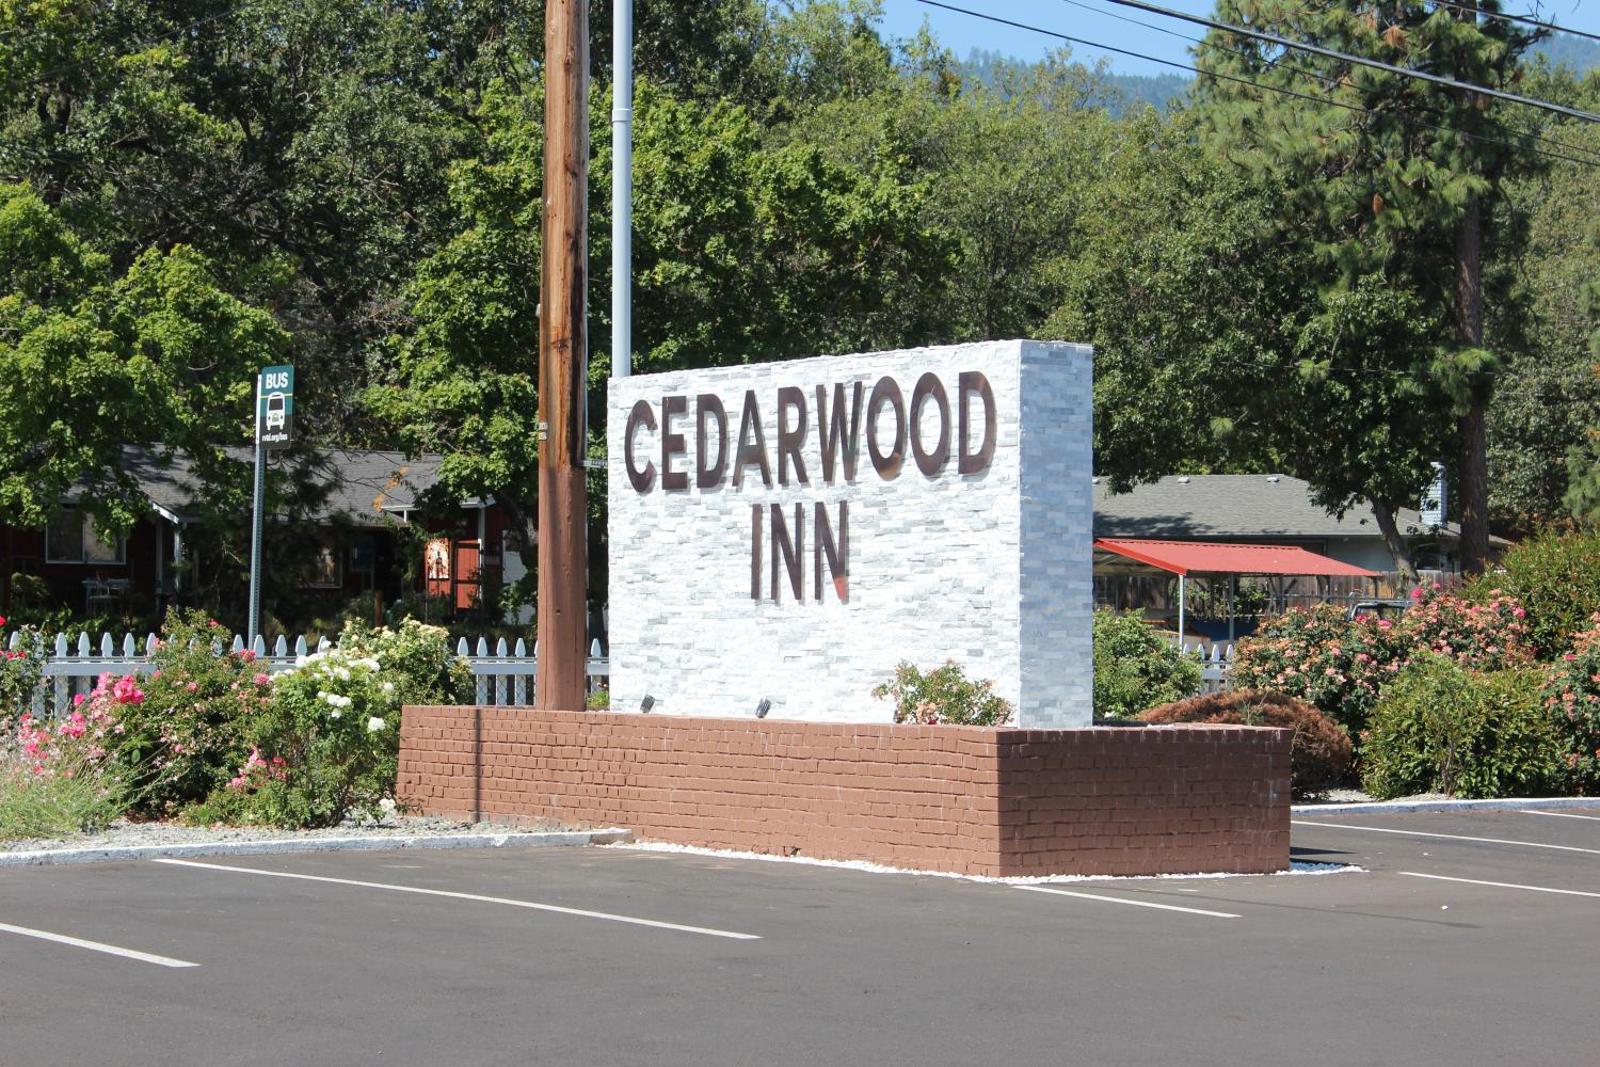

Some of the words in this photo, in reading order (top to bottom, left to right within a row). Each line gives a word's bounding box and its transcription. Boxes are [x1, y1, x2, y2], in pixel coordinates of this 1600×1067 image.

[265, 372, 288, 389] BUS
[625, 371, 997, 493] CEDARWOOD
[751, 500, 849, 602] INN
